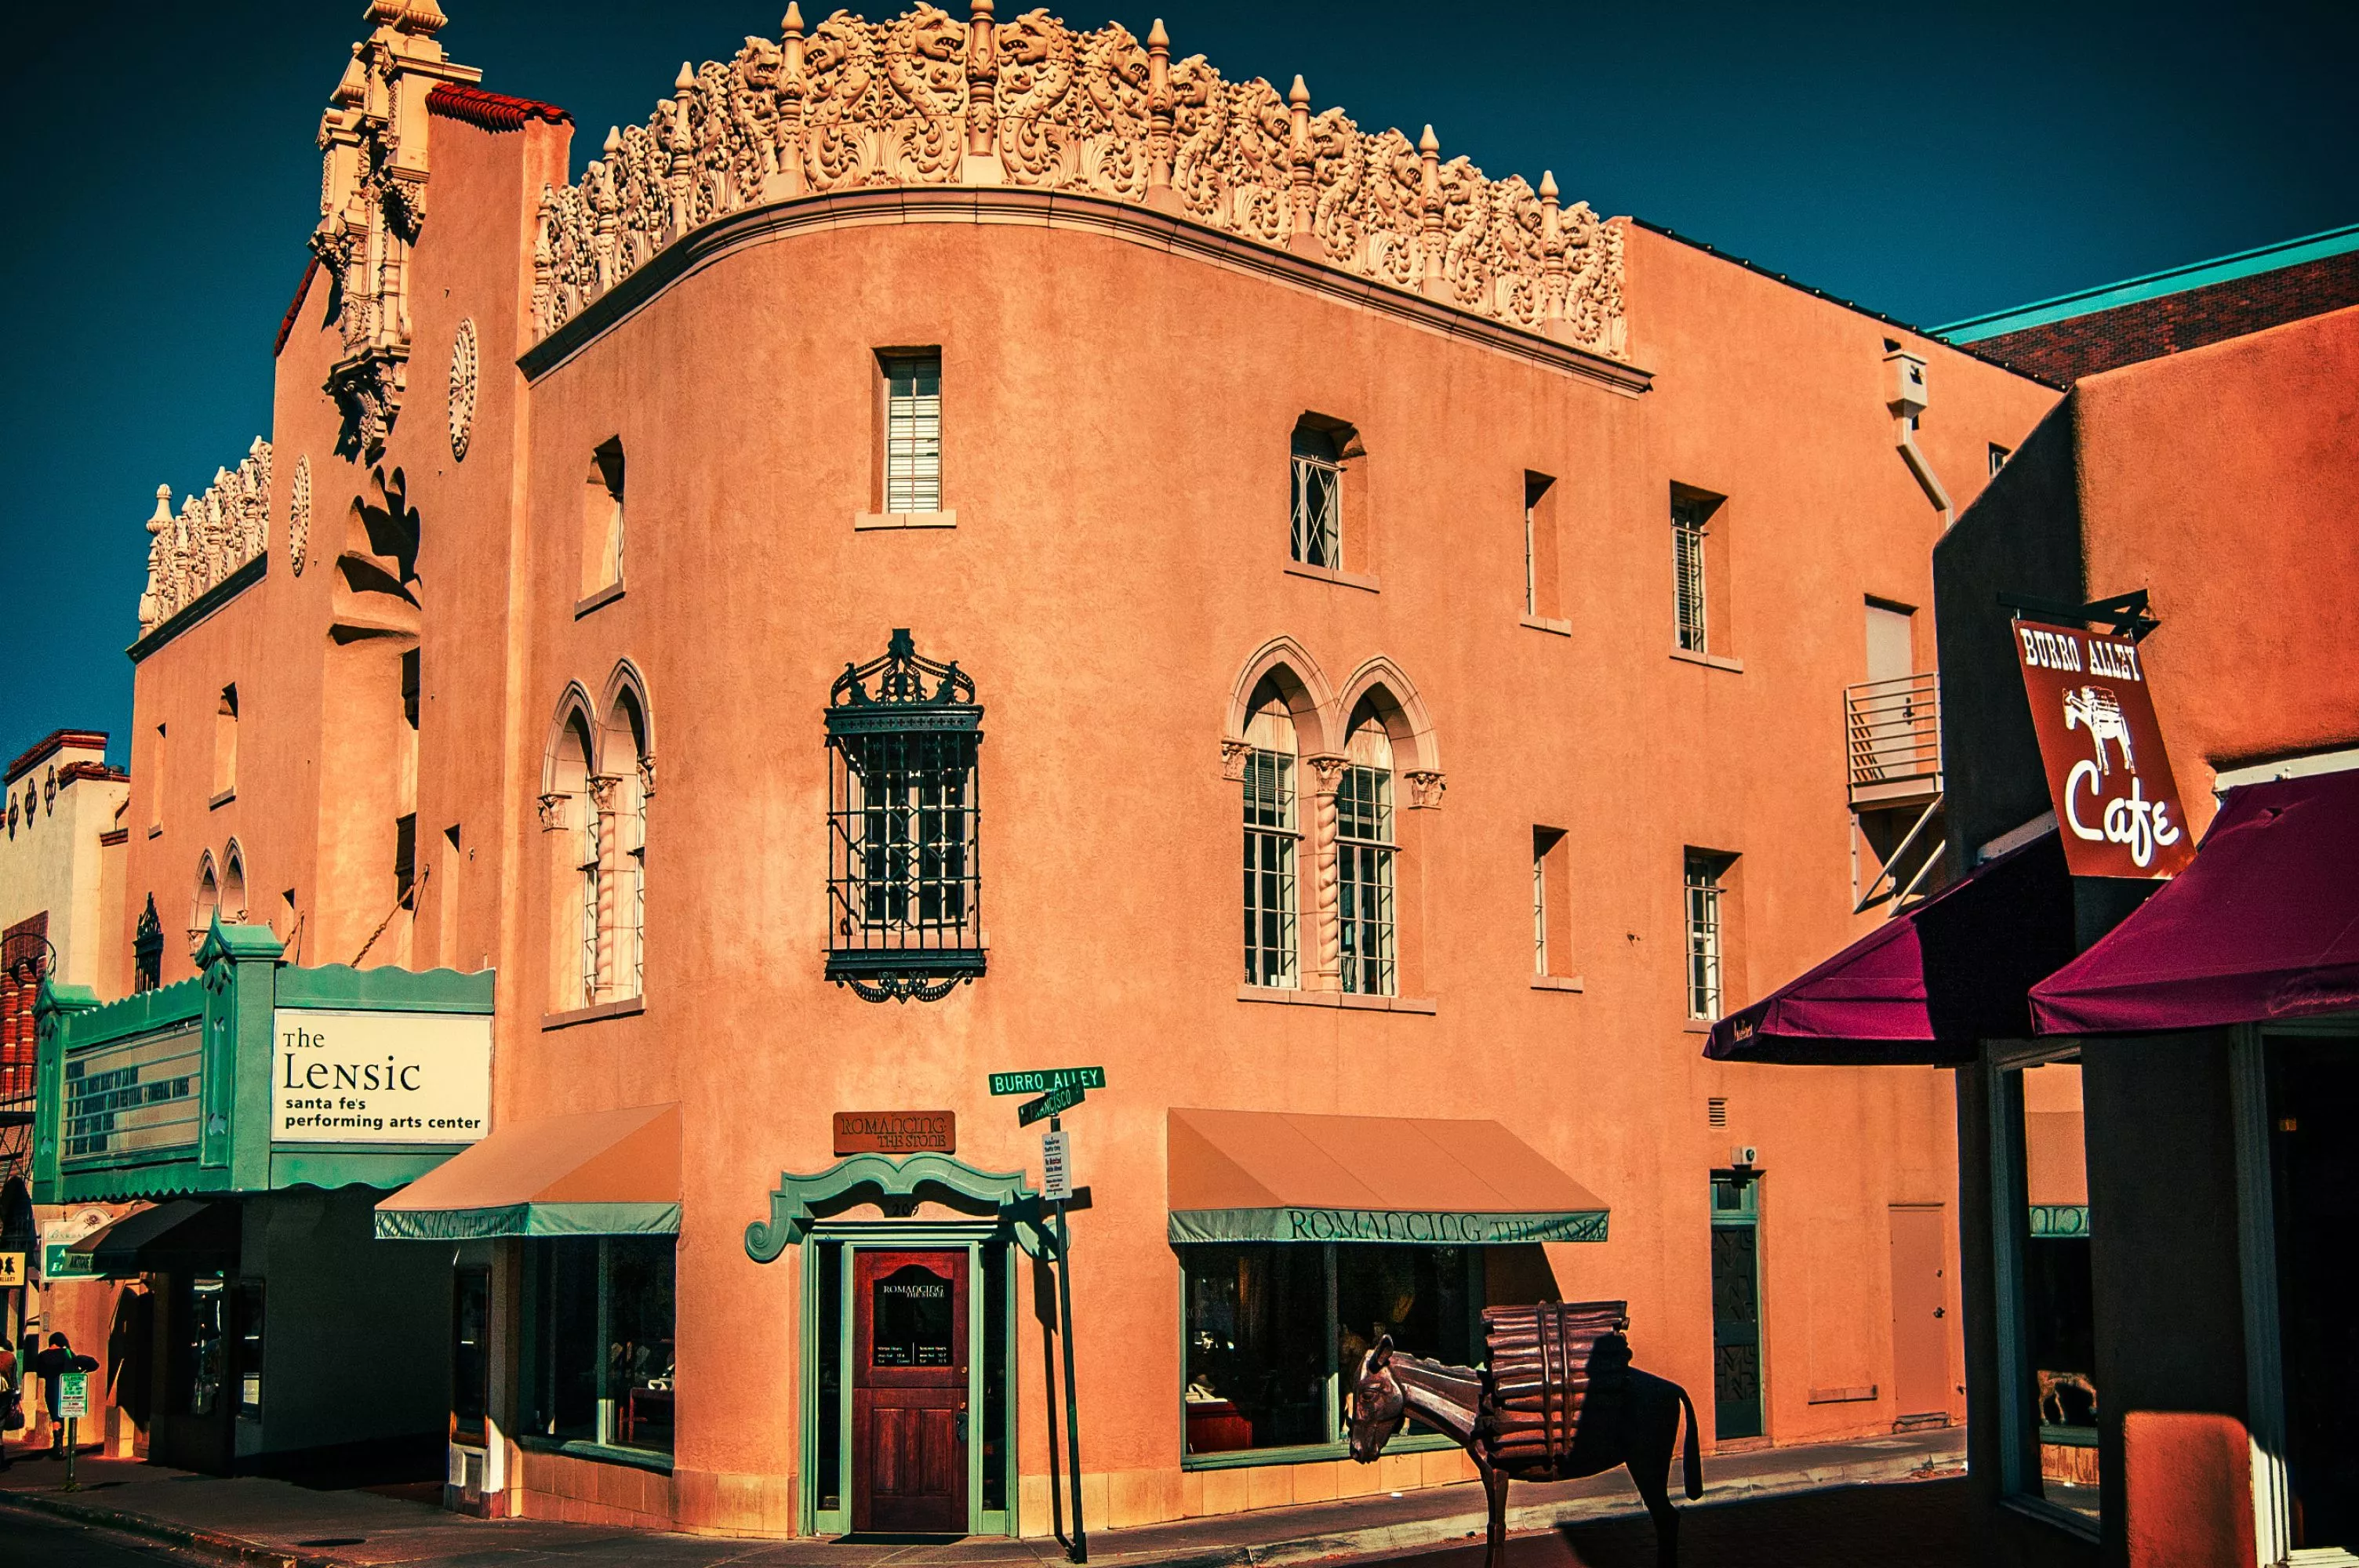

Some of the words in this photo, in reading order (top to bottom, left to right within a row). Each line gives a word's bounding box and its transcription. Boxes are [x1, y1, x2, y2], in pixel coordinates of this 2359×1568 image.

[2019, 629, 2081, 672] BURRO
[2088, 640, 2140, 681] ALLEY
[2065, 760, 2179, 867] Cafe
[283, 1027, 325, 1047] The
[994, 1073, 1044, 1093] BURRO
[1054, 1069, 1098, 1089] ALLEY
[285, 1098, 333, 1109] santa
[340, 1098, 365, 1109] fe's
[1030, 1089, 1071, 1120] FRANCISCO
[285, 1114, 383, 1130] performing
[390, 1116, 422, 1128] arts
[428, 1116, 481, 1129] center
[841, 1117, 946, 1134] ROMANCING
[878, 1135, 903, 1147] THE
[906, 1135, 946, 1147] STONE
[892, 1203, 919, 1217] 209
[1289, 1210, 1481, 1241] ROMANCING
[1490, 1221, 1535, 1241] THE
